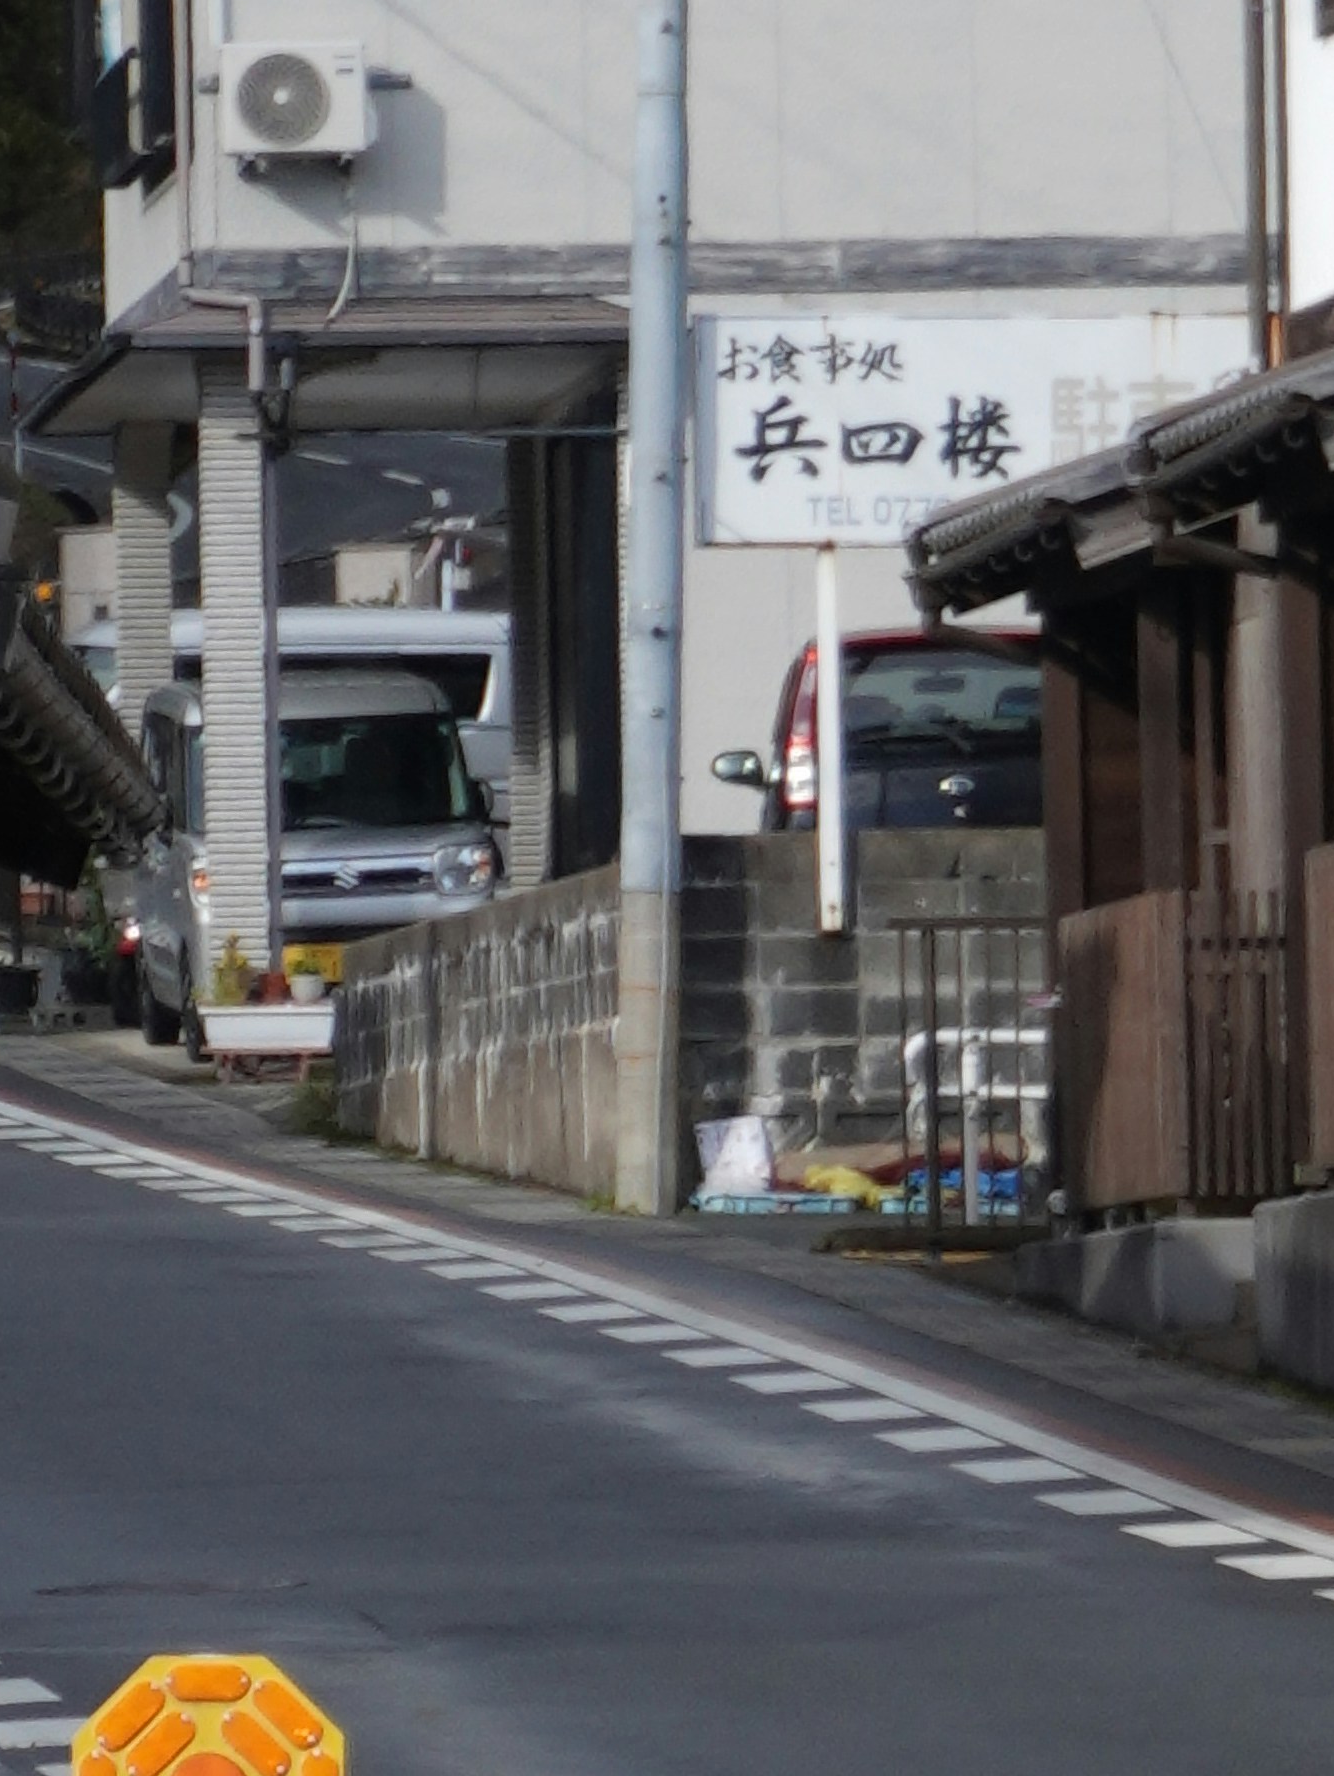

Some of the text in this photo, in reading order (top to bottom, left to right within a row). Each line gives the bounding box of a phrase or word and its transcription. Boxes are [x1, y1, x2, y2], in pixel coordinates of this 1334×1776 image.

[717, 334, 904, 384] お食事処
[735, 396, 1021, 482] 兵四楼
[807, 495, 953, 526] TEL 077
